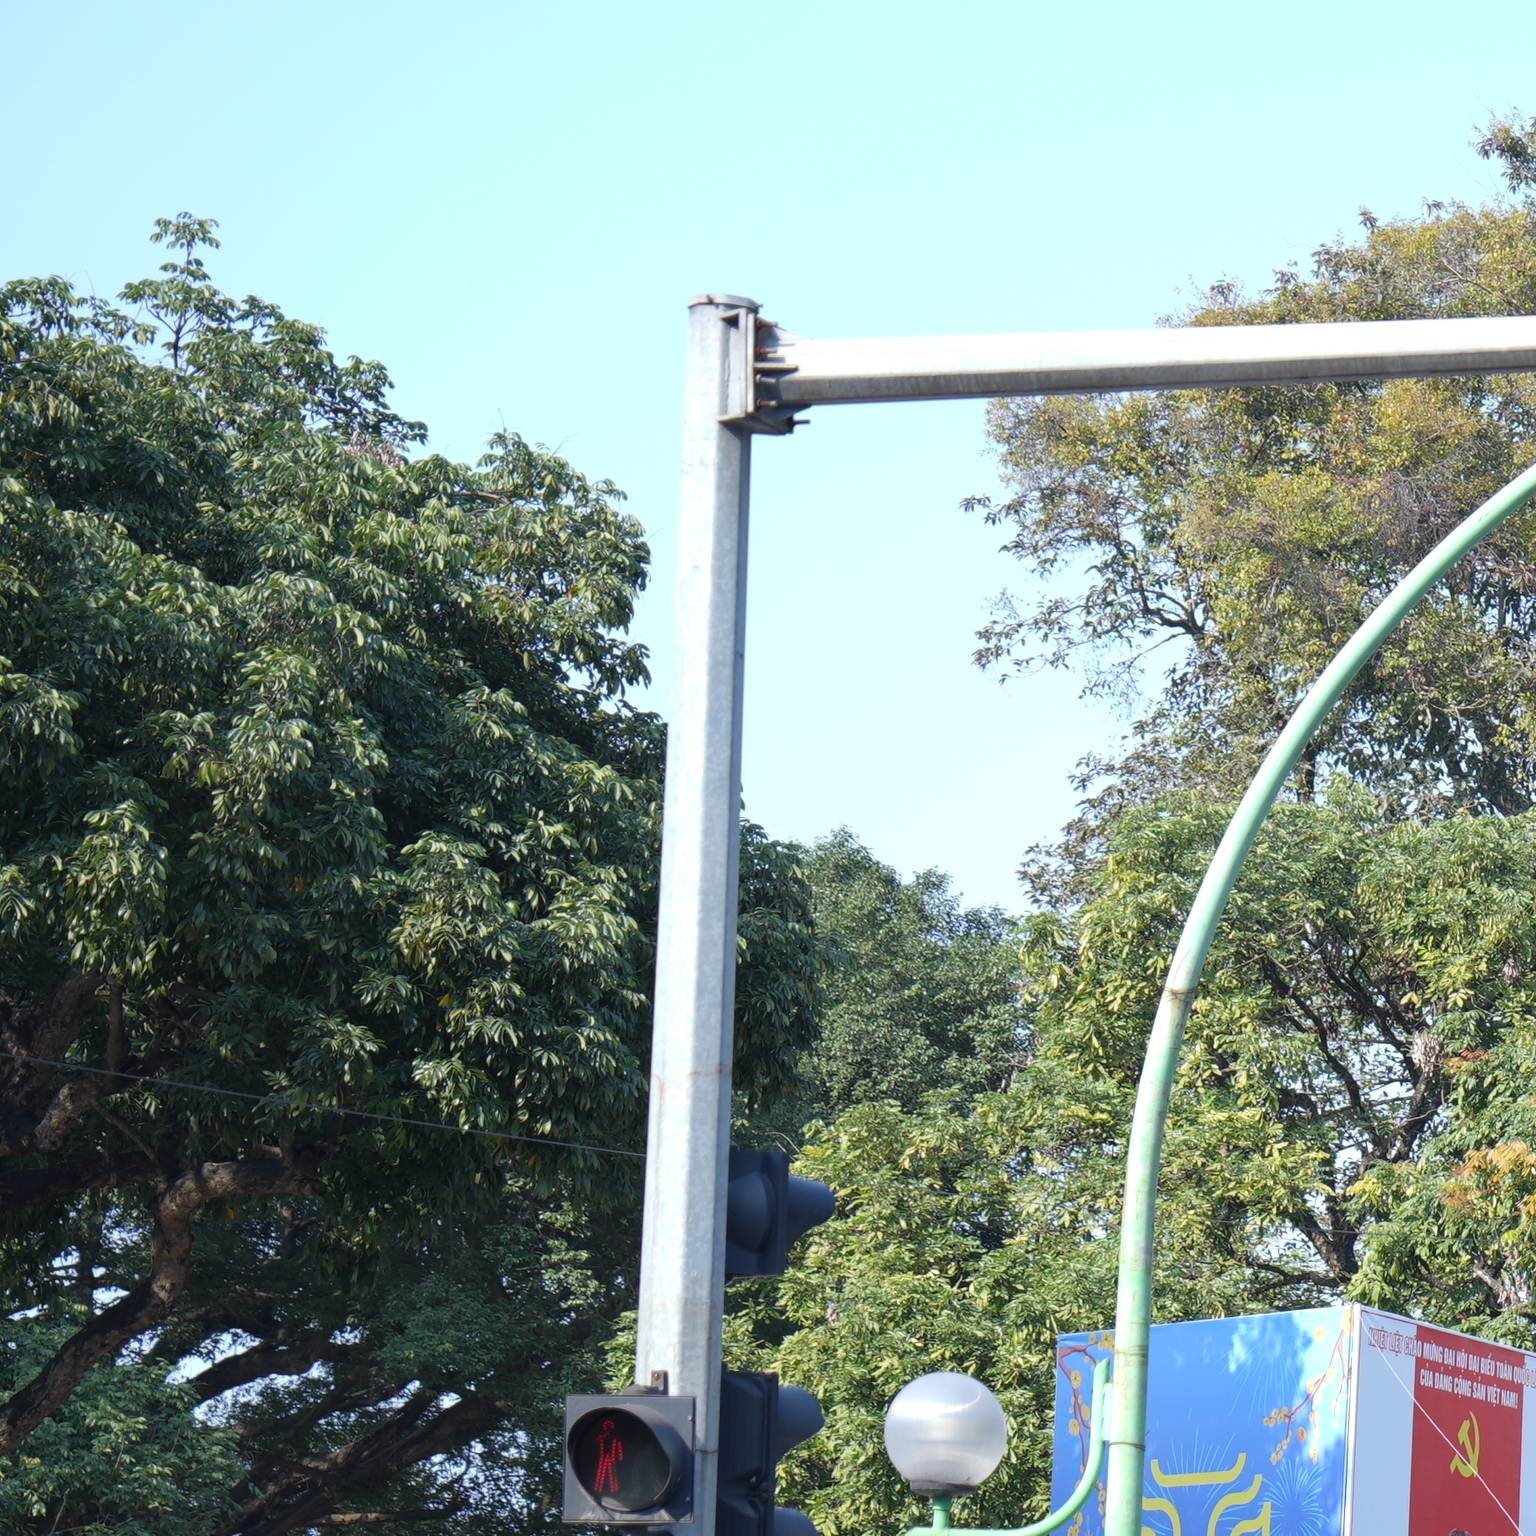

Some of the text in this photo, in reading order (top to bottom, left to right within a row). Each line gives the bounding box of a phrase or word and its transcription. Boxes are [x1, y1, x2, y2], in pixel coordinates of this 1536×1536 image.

[1404, 1335, 1422, 1358] CHÀO
[1423, 1341, 1443, 1363] MỪNG
[1444, 1349, 1455, 1368] ĐẠI
[1456, 1350, 1468, 1371] HỘI
[1469, 1354, 1480, 1376] ĐẠI
[1480, 1352, 1495, 1376] BIỂU
[1496, 1359, 1513, 1381] TOÀN
[1514, 1361, 1530, 1386] QUỐC
[1420, 1363, 1518, 1409] CỦA ĐẢNG CỘNG SẢN VIỆT NAM!
